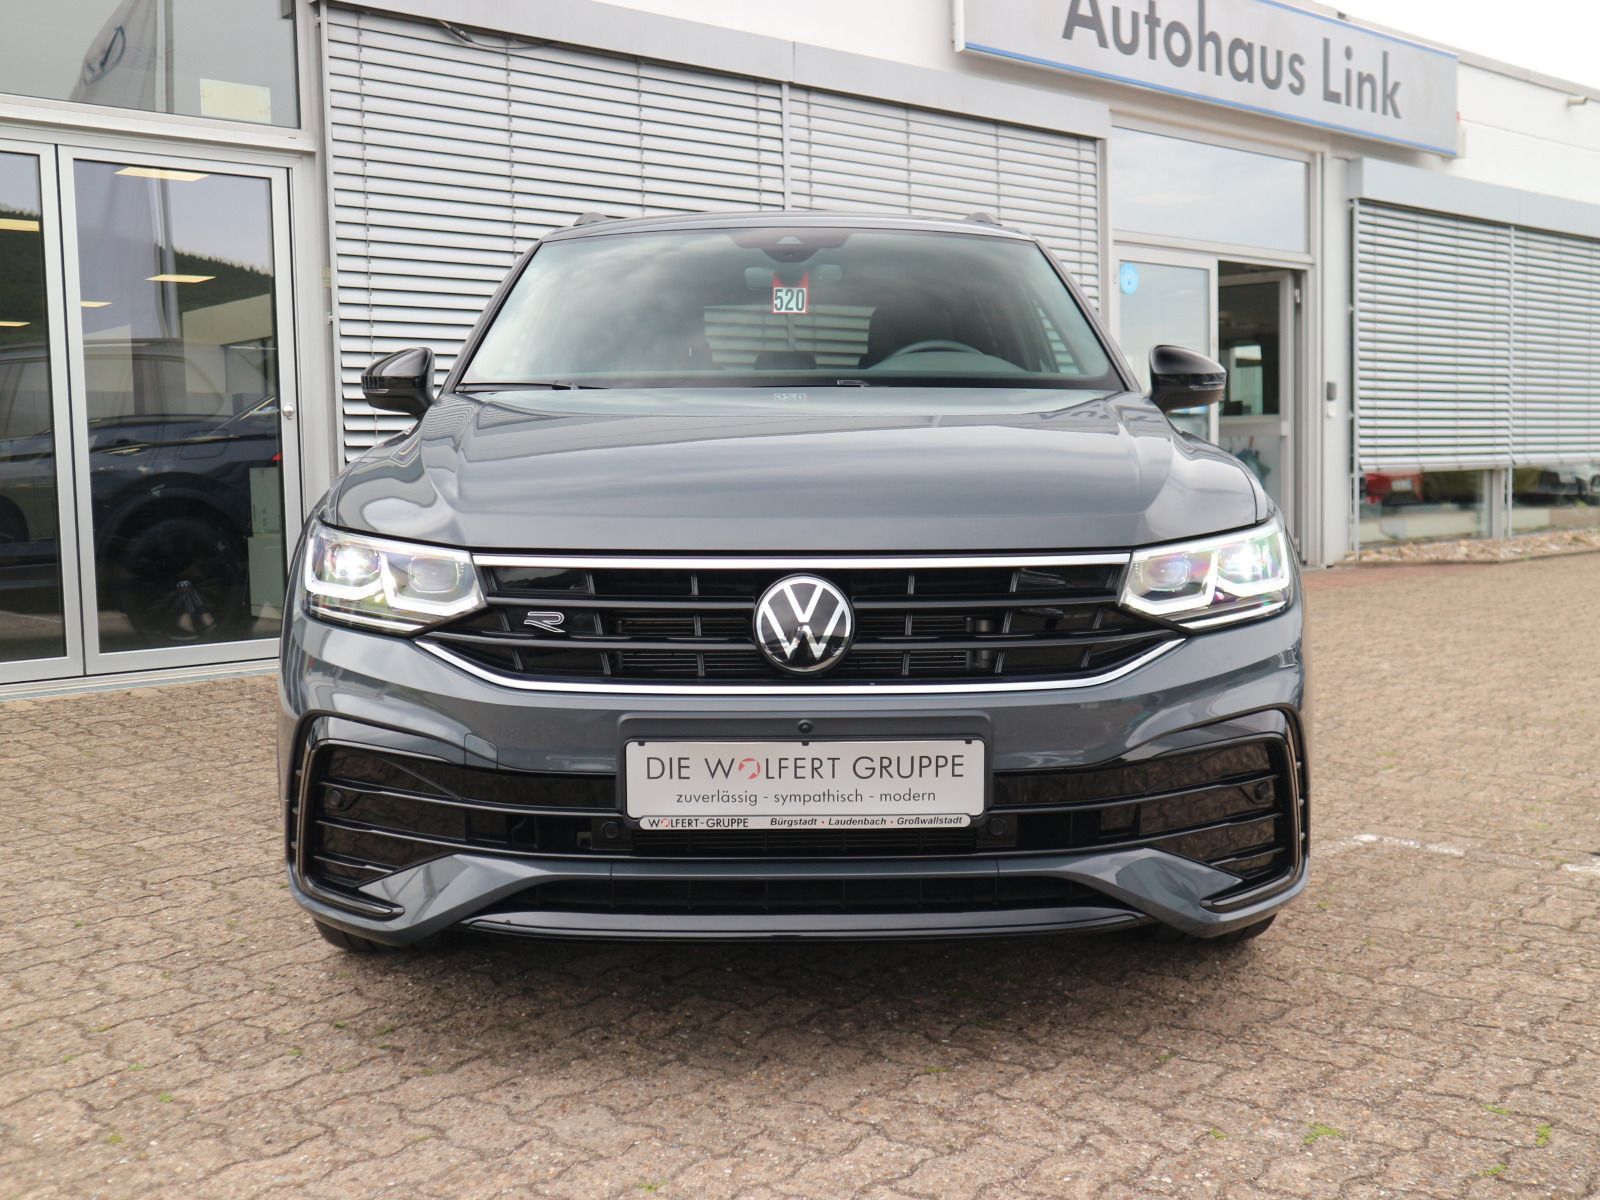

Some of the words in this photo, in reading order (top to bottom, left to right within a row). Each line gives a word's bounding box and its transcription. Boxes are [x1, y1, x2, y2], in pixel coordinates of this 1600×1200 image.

[1062, 0, 1306, 98] Autohaus
[1322, 37, 1402, 119] Link
[774, 288, 805, 312] 520
[646, 756, 691, 780] DIE
[704, 757, 841, 780] WOLFERT
[852, 755, 965, 780] GRUPPE
[676, 788, 758, 807] zuverlässig
[774, 788, 863, 807] sympathisch
[879, 787, 936, 803] modern
[770, 817, 818, 827] Bürgstadt
[828, 817, 887, 826] Laudenbach
[896, 816, 963, 826] Großwallstadt
